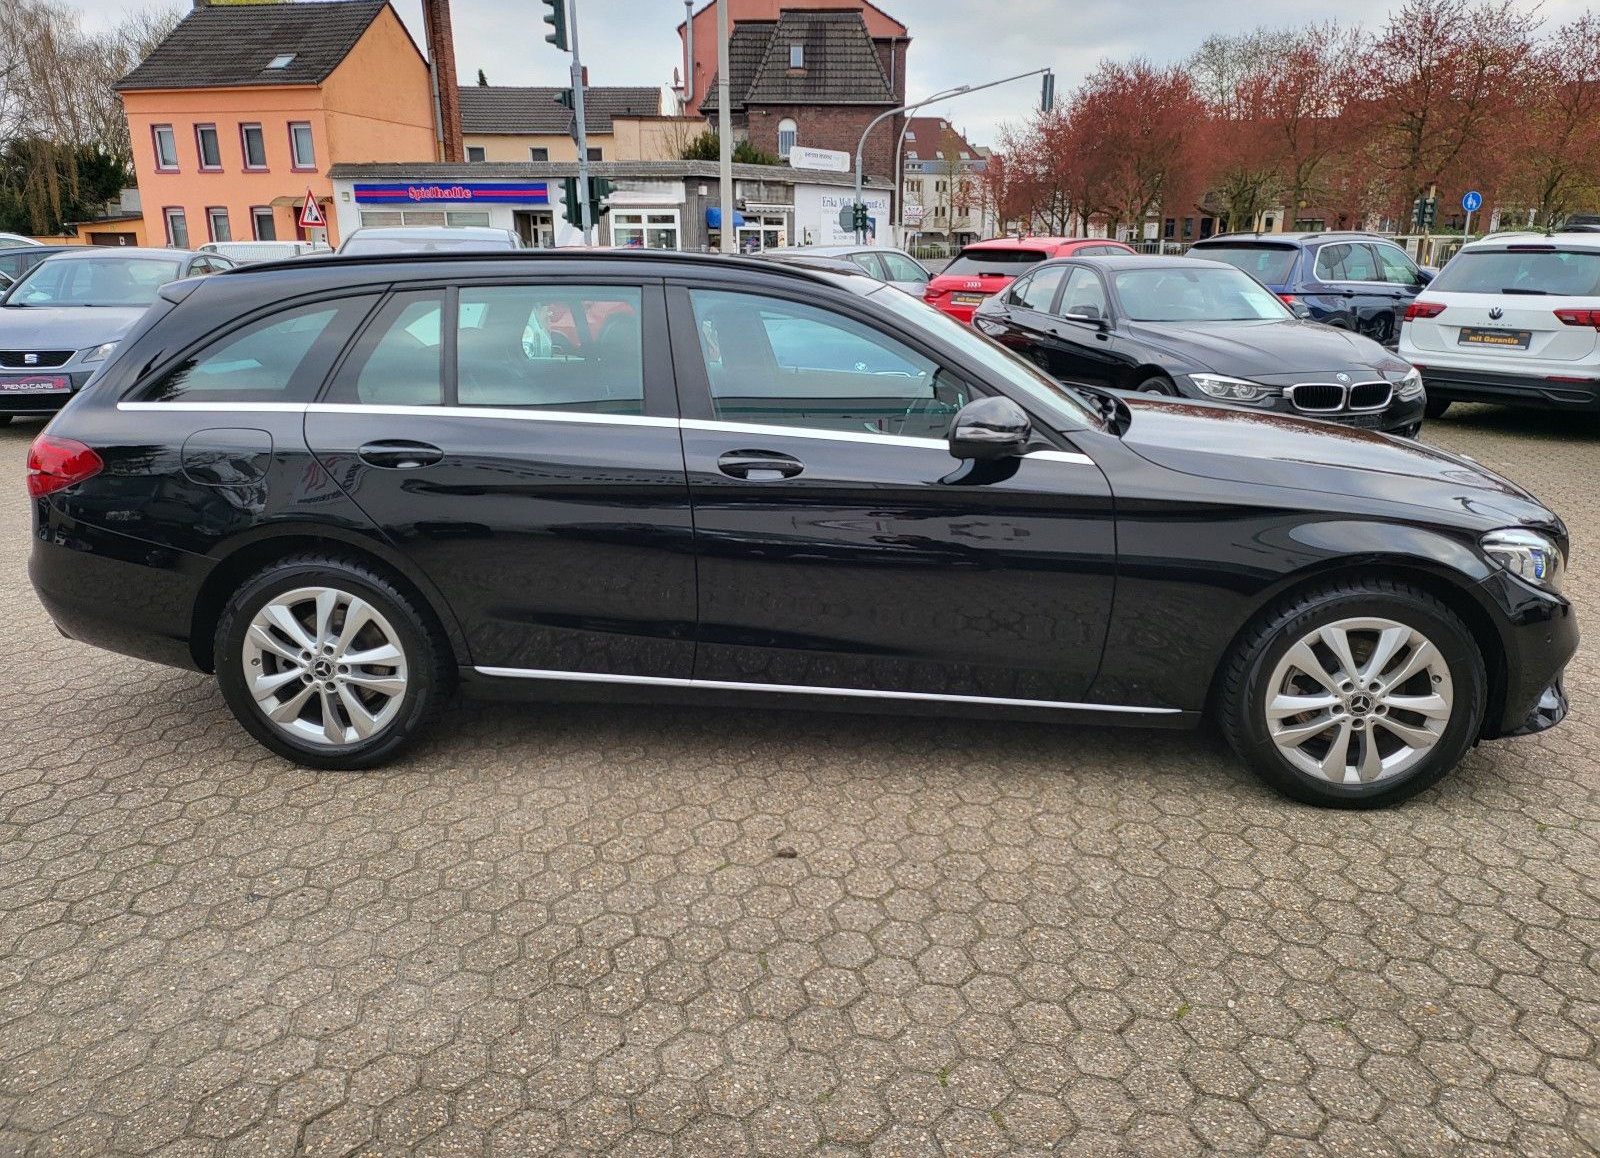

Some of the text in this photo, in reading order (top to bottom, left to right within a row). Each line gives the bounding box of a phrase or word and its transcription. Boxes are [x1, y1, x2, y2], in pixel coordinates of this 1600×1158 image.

[408, 186, 472, 201] Spielhalle
[1469, 334, 1482, 342] mit
[1483, 336, 1519, 345] Garantie
